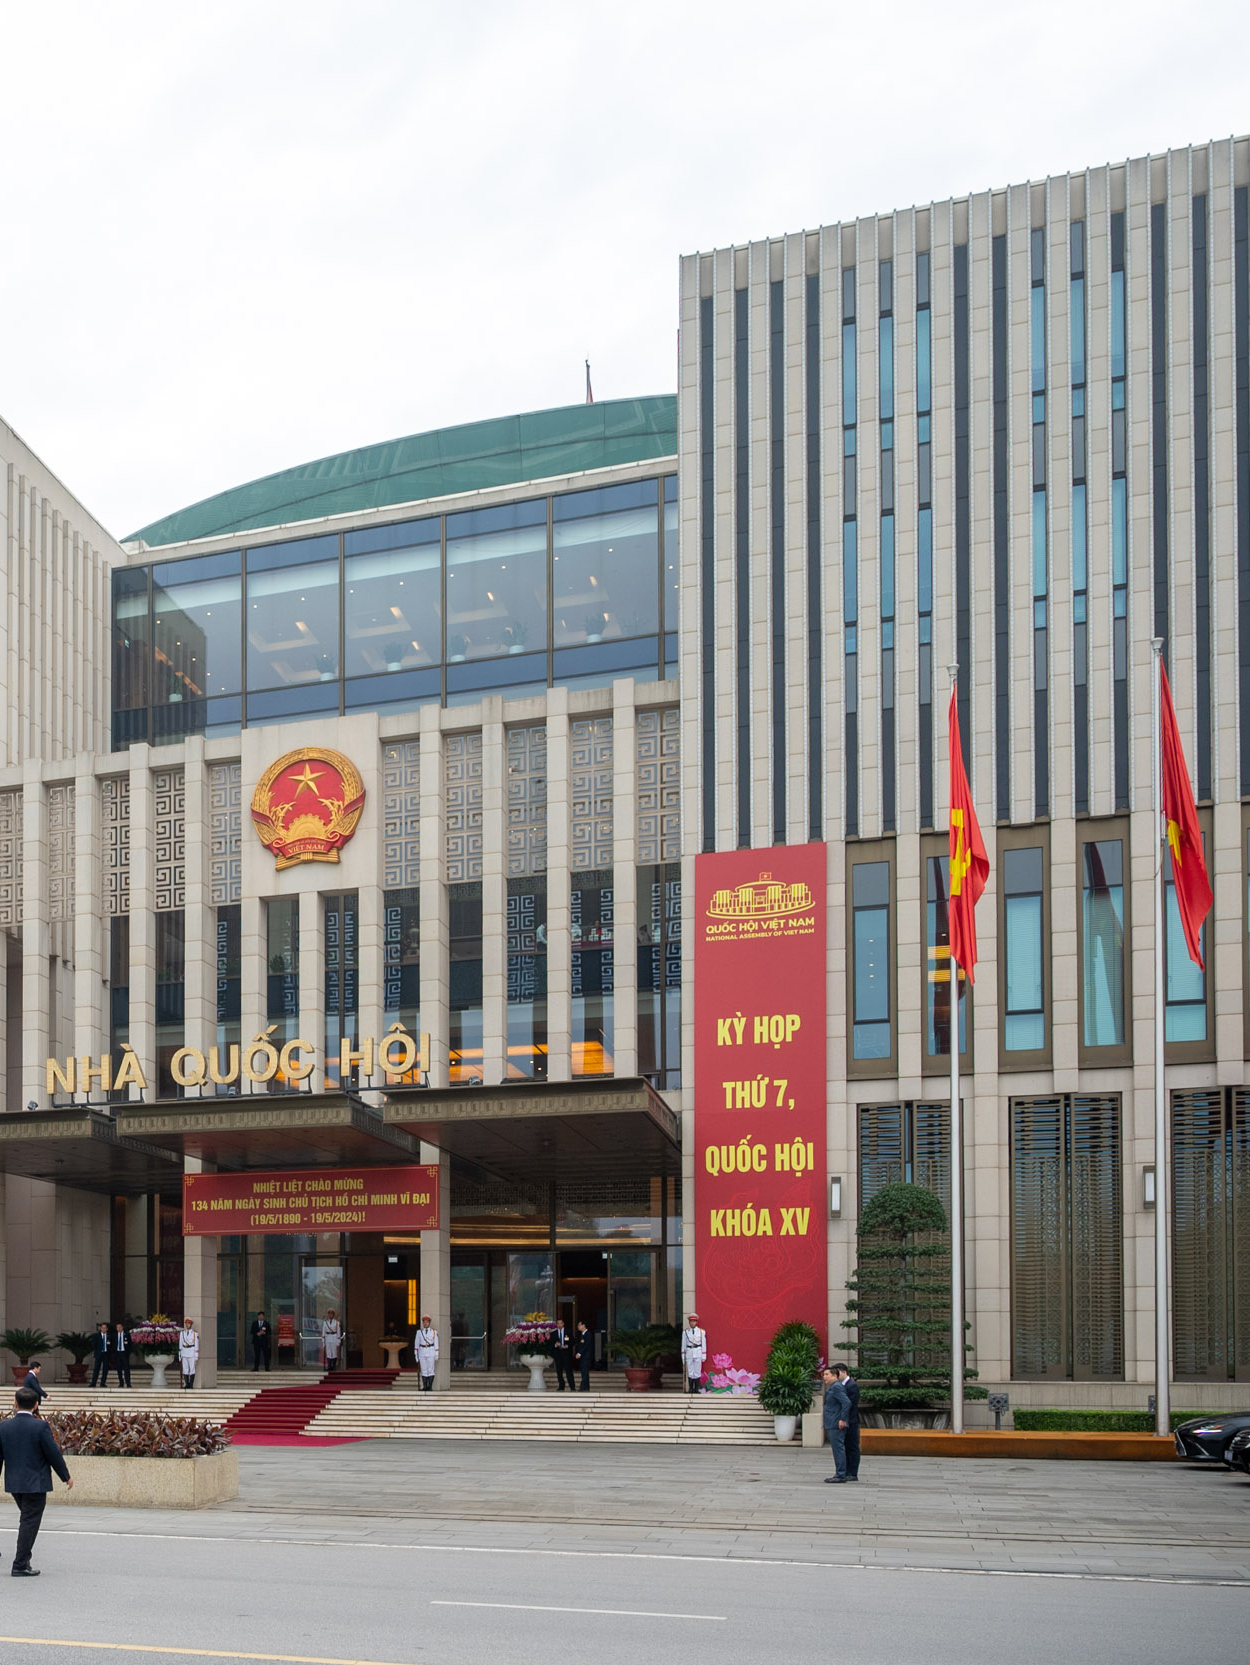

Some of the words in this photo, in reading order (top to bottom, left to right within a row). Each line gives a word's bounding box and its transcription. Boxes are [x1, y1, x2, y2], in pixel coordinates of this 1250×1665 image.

[706, 921, 737, 934] QUỐC
[739, 920, 758, 932] HỘI
[761, 918, 786, 930] VIỆT
[788, 917, 814, 927] NAM
[717, 1011, 746, 1046] KỲ
[754, 1014, 801, 1049] HỌP
[46, 1043, 148, 1095] NHÀ
[170, 1025, 315, 1087] QUỐC
[340, 1022, 431, 1083] HỘI
[722, 1074, 770, 1109] THỨ
[773, 1079, 795, 1110] 7,
[705, 1134, 767, 1176] QUỐC
[775, 1137, 814, 1177] HỘI
[191, 1200, 208, 1211] 134
[211, 1198, 233, 1210] NĂM
[235, 1197, 261, 1209] NGÀY
[263, 1198, 286, 1208] SINH
[289, 1193, 308, 1208] CHỦ
[311, 1196, 332, 1209] TỊCH
[335, 1192, 349, 1206] HỒ
[351, 1193, 368, 1206] CHÍ
[371, 1194, 397, 1205] MINH
[400, 1192, 410, 1204] VĨ
[413, 1193, 430, 1206] ĐẠI
[253, 1180, 281, 1195] NHIỆT
[283, 1179, 302, 1194] LIỆT
[306, 1178, 331, 1191] CHÀO
[334, 1177, 364, 1190] MỪNG
[251, 1214, 301, 1226] (19/5/1890
[311, 1212, 366, 1223] 19/5/2024)!
[710, 1202, 773, 1236] KHÓA
[779, 1207, 810, 1235] XV
